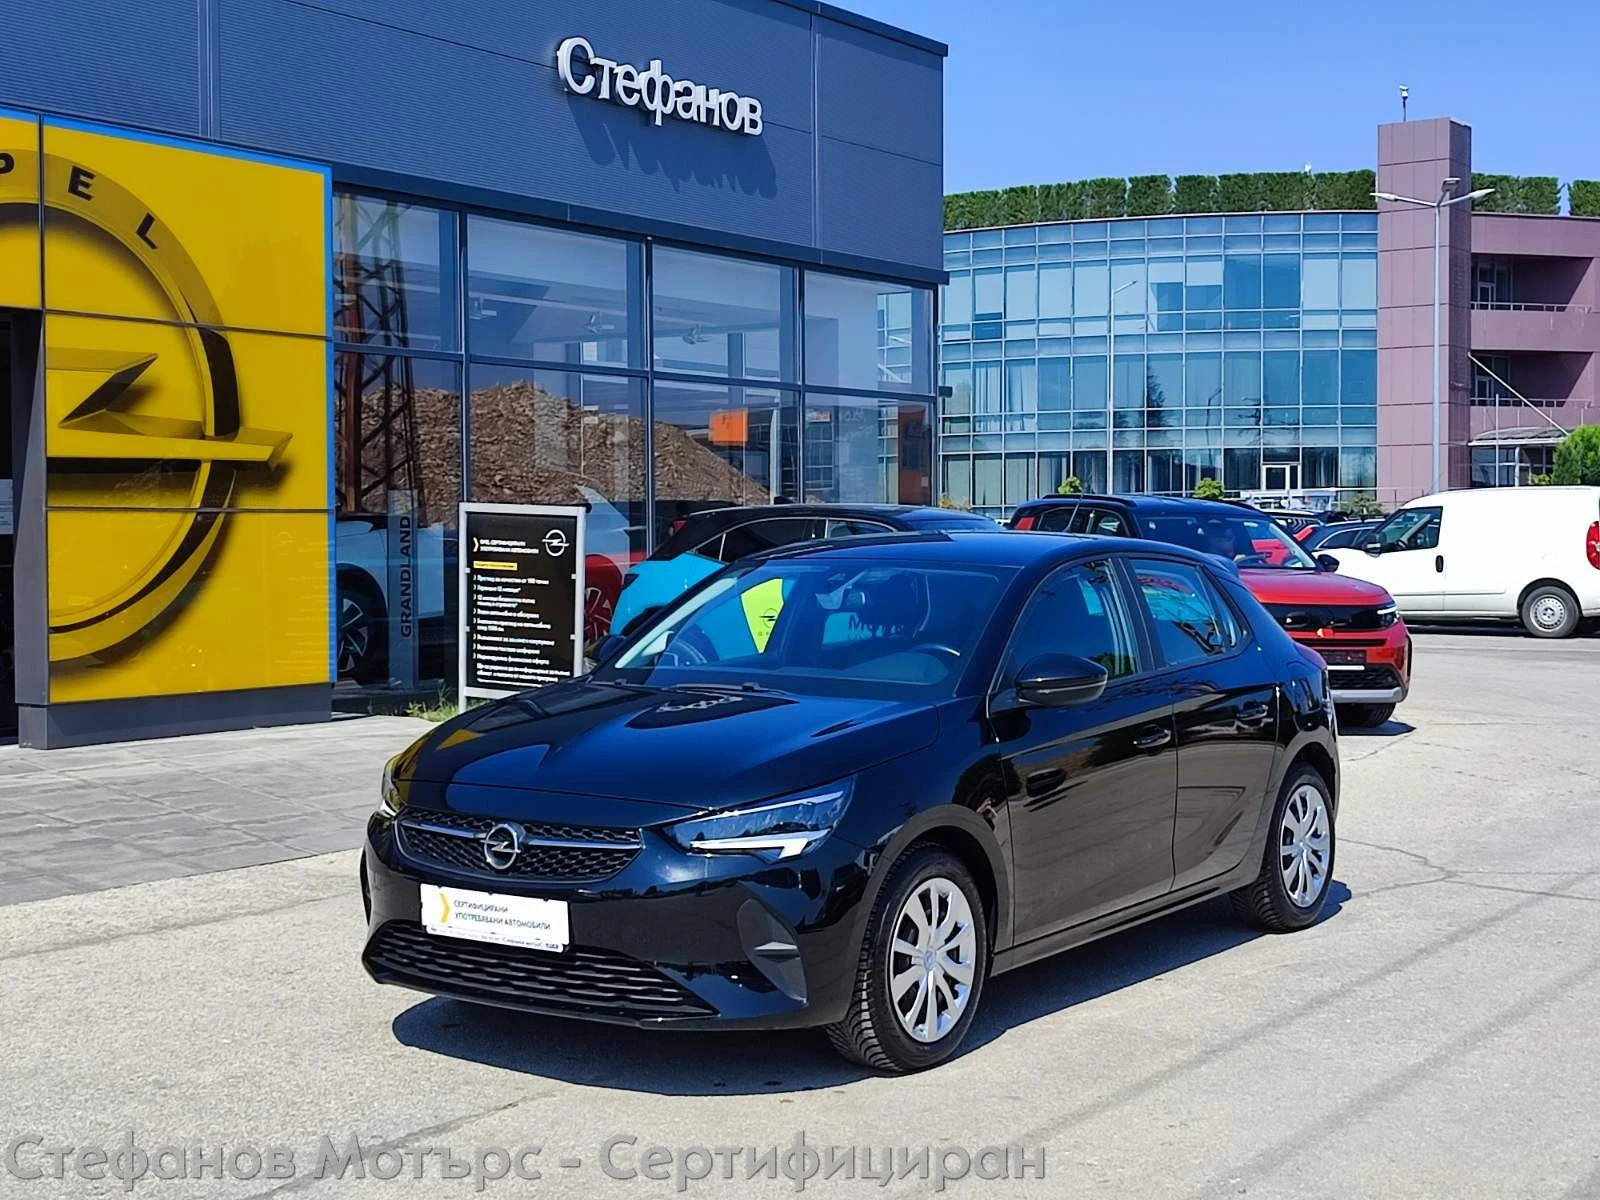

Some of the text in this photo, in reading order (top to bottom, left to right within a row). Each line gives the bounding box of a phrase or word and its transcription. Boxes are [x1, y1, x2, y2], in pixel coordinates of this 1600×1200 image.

[556, 37, 763, 136] Стефанов
[399, 516, 412, 637] GRANDLAND
[453, 900, 508, 913] СЕРТИФИЦИРАНИ
[454, 912, 552, 931] УПОТРЕБЯВАНИ АВТОМОБИЛИ
